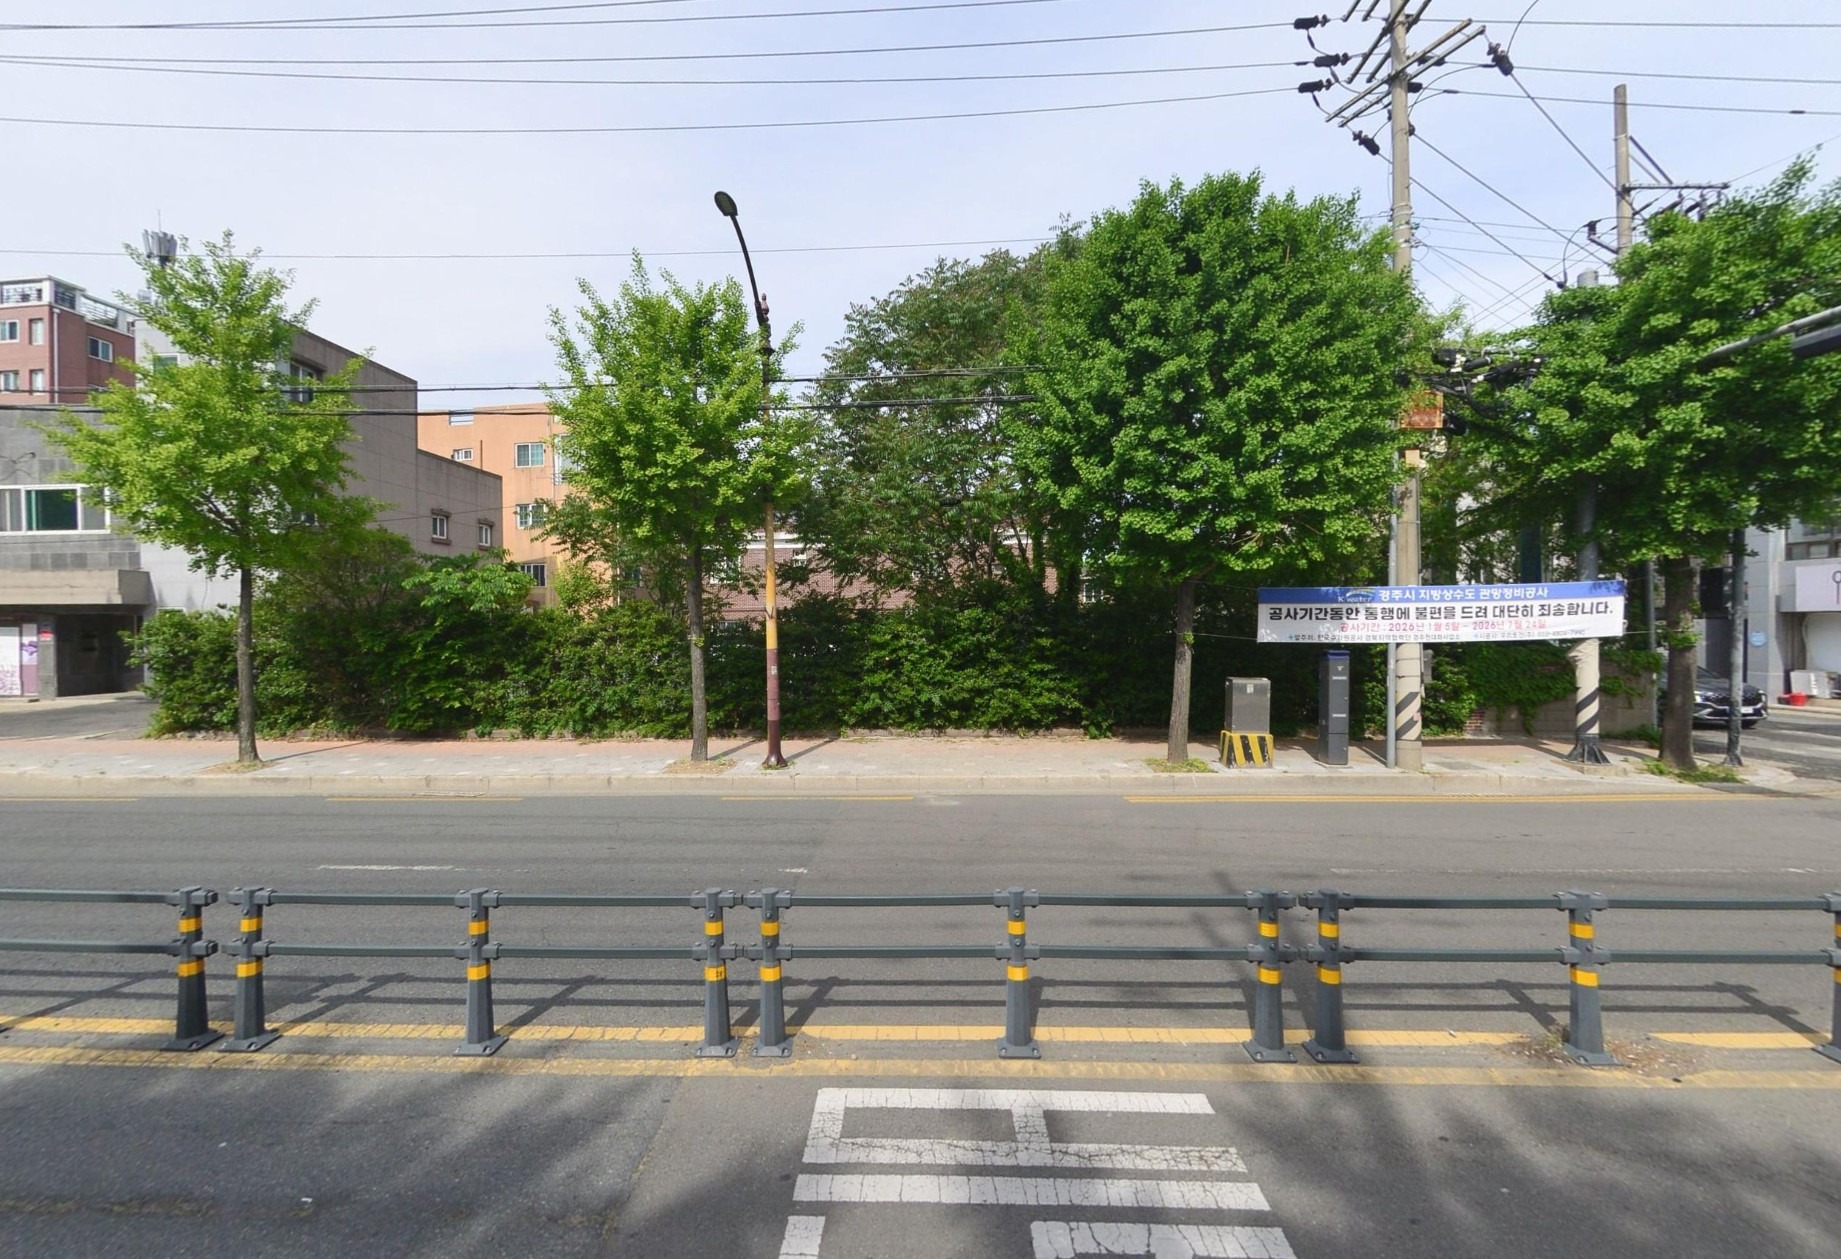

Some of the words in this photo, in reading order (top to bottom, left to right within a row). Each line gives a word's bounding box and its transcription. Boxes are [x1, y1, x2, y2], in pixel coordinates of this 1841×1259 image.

[1378, 588, 1416, 601] 경주시
[1419, 587, 1476, 601] 지방상수도
[1479, 586, 1549, 600] 관망정비공사
[1268, 607, 1360, 621] 공사기간동안
[1364, 606, 1411, 621] 통행에
[1415, 606, 1457, 620] 불편을
[1460, 605, 1488, 619] 드려
[1492, 603, 1534, 618] 대단히
[1537, 602, 1614, 617] 죄송합니다.
[1340, 622, 1381, 632] 공사기간
[1388, 622, 1425, 632] 2026년
[1429, 622, 1442, 632] 1월
[1472, 621, 1505, 631] 2026년
[1508, 620, 1523, 630] 7월
[1526, 619, 1547, 630] 24일
